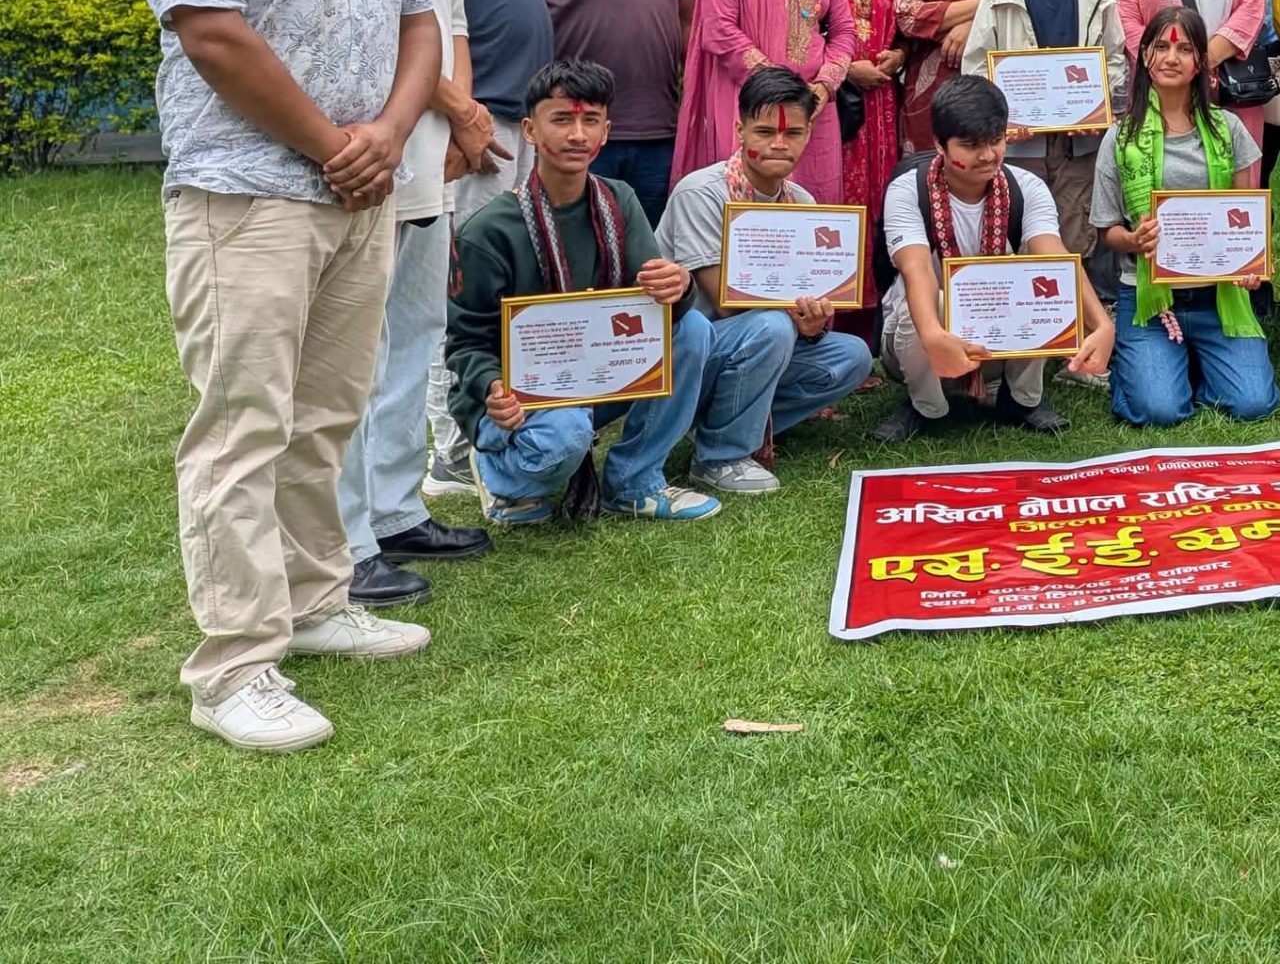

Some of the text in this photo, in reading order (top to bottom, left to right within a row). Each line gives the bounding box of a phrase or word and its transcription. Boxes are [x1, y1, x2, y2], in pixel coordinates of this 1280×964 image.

[876, 502, 1005, 524] अखिल
[1018, 493, 1126, 518] नेपाल
[1138, 482, 1261, 508] राष्ट्रिय
[1009, 516, 1108, 533] जिल्ला
[1117, 504, 1214, 524] कमिटी
[919, 590, 968, 600] मिति
[919, 597, 977, 609] स्थान
